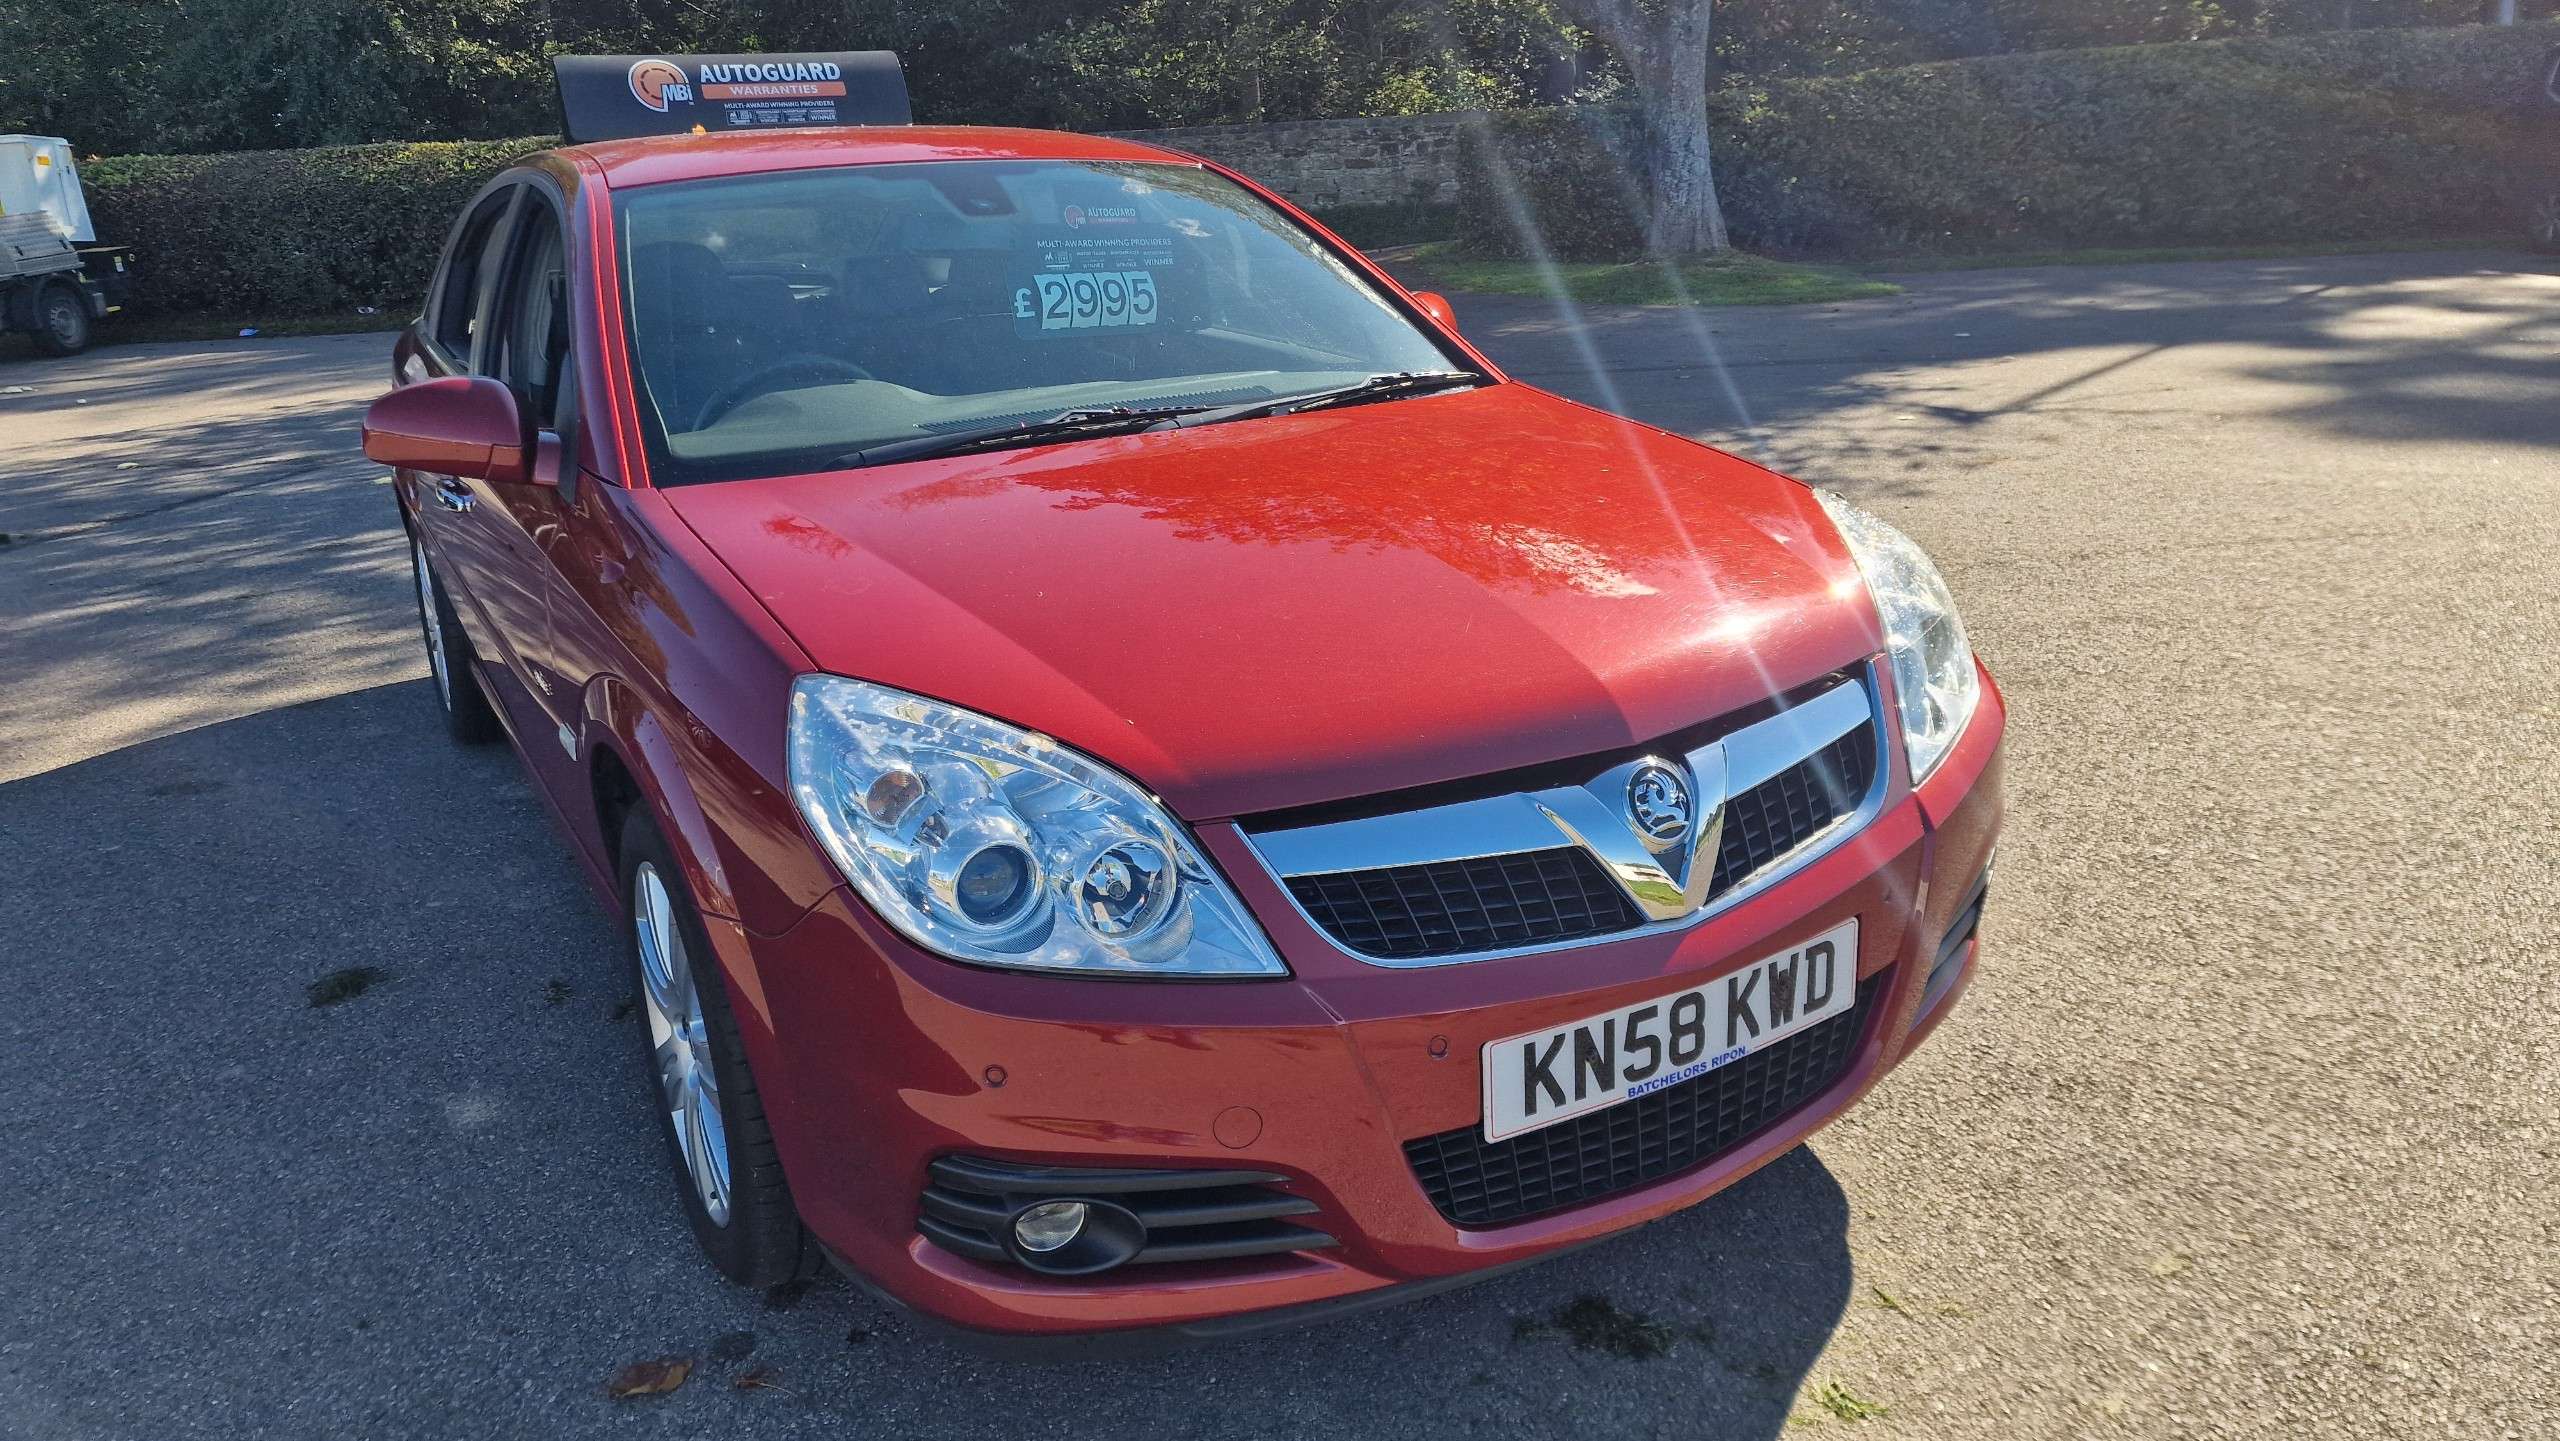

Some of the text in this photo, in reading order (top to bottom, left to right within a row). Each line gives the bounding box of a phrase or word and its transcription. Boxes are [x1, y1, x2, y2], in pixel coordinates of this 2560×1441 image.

[701, 62, 841, 83] AUTOGUARD
[730, 84, 818, 96] WARRANTIES
[724, 101, 769, 109] MULTI-AWARD
[1088, 207, 1136, 217] AUTOGUARD
[1037, 238, 1172, 249] MULTI-AWARD WINNING PROVIDERS
[1144, 257, 1174, 266] WINNER
[1523, 939, 1836, 1117] KN58 KWD
[1627, 1045, 1748, 1099] BATCHELORS RIPON
